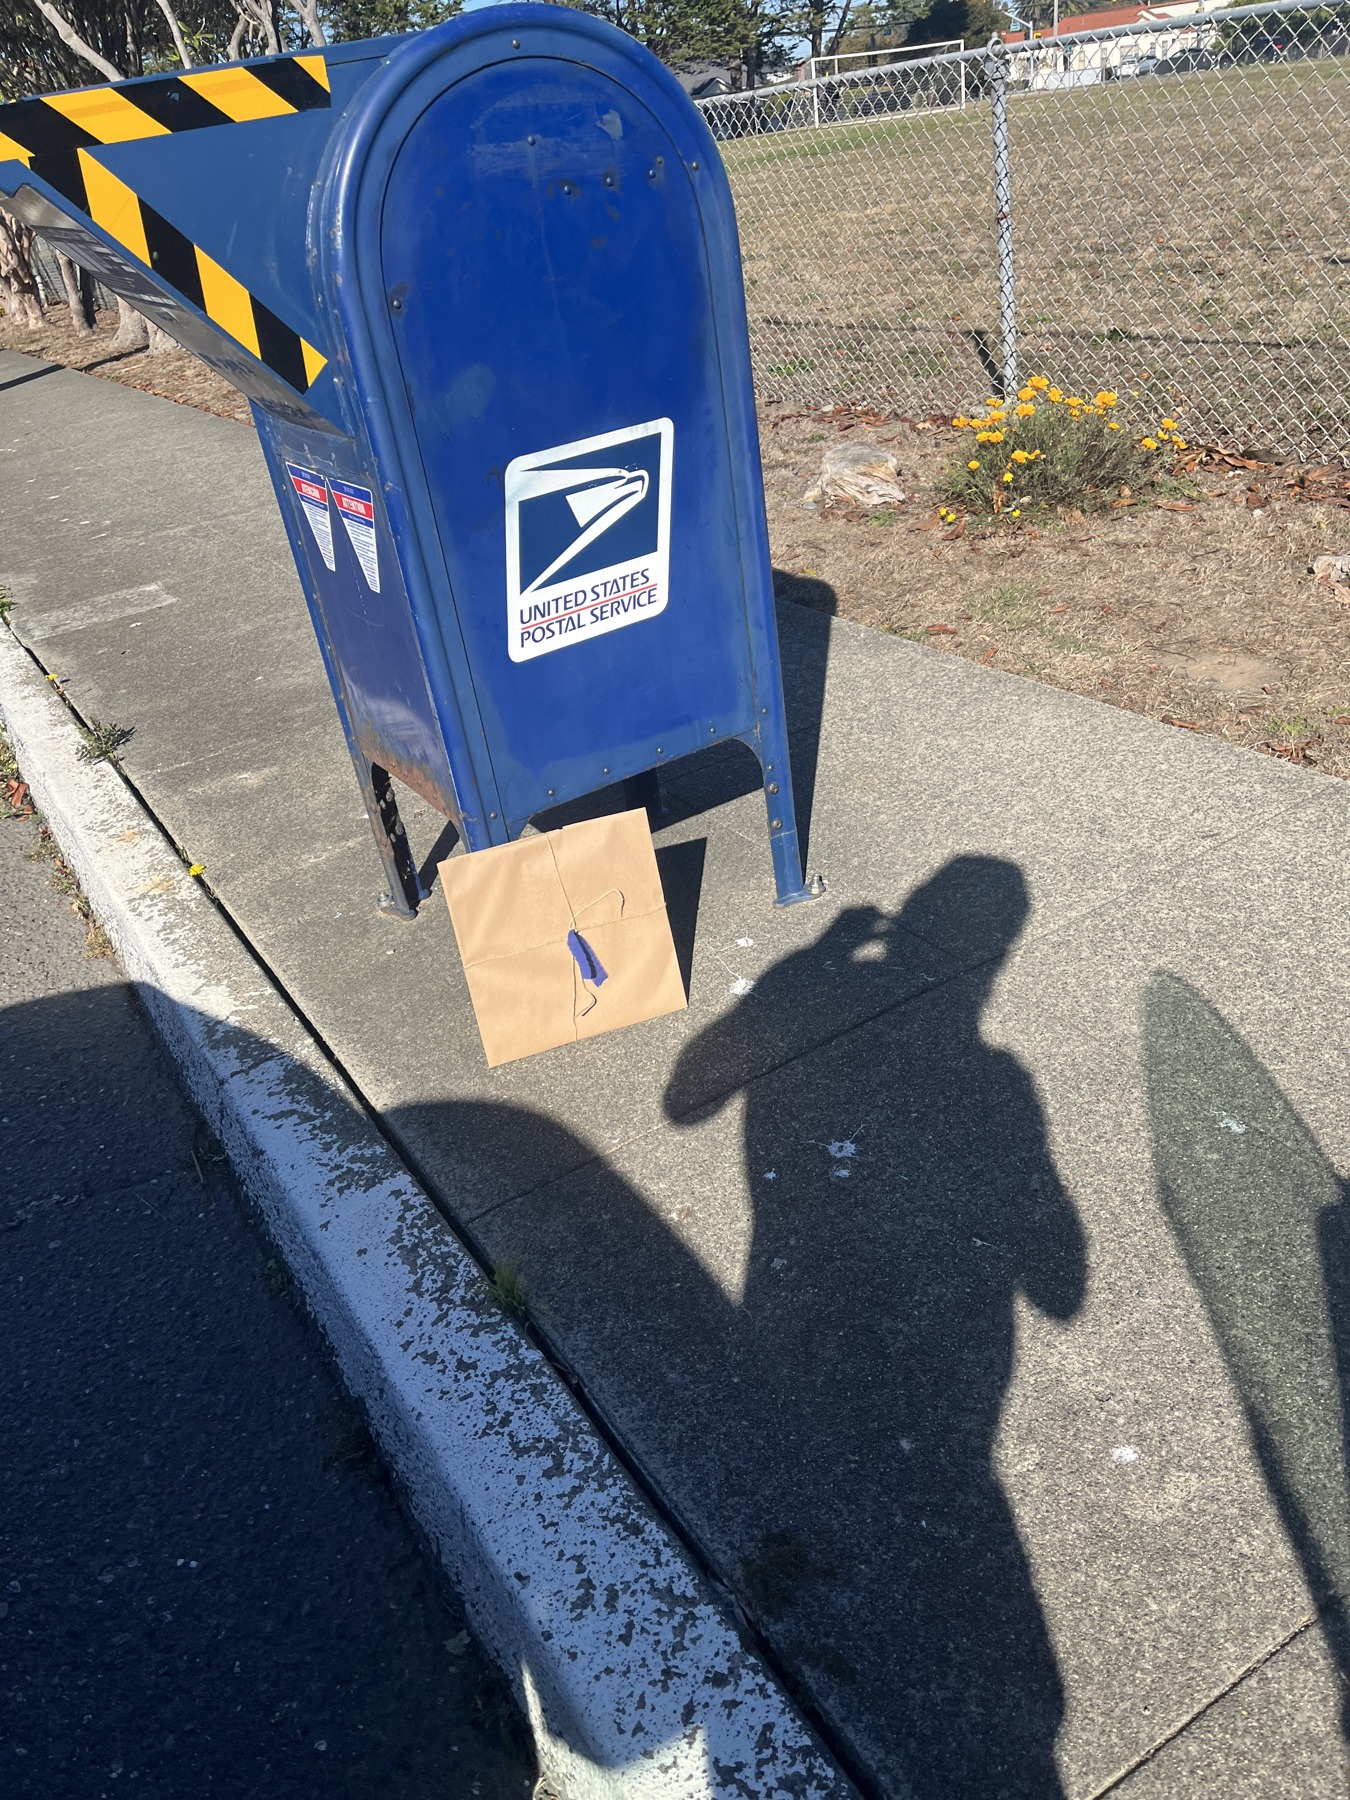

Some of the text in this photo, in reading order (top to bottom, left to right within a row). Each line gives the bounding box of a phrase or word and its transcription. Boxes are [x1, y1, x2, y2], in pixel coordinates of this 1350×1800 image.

[520, 568, 650, 625] UNITED STATES
[521, 587, 657, 648] POSTAL SERVICE
